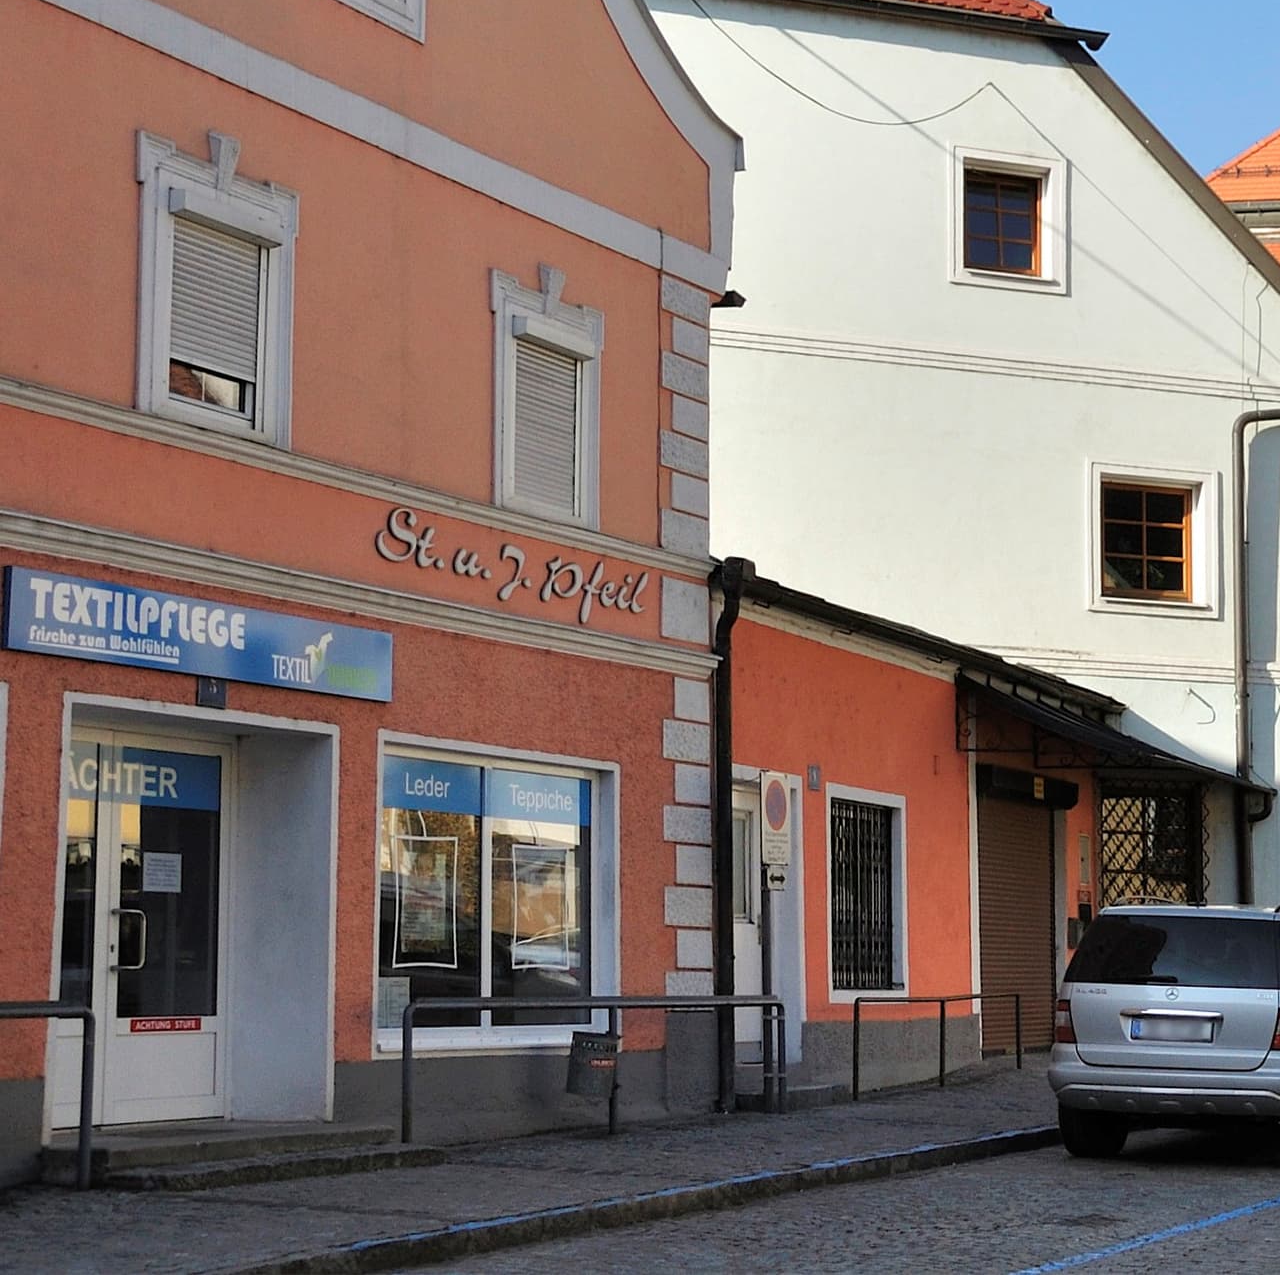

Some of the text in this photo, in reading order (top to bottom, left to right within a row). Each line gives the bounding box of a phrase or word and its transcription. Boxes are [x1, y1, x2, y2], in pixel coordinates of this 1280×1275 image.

[453, 547, 492, 579] u.
[540, 556, 649, 624] Pfeil
[30, 577, 245, 651] TEXTILPFLEGE
[78, 635, 106, 649] zum
[109, 634, 181, 658] Wohlfühlen
[271, 653, 313, 684] TEXTIL
[405, 772, 451, 798] Leder
[509, 783, 573, 813] Teppiche
